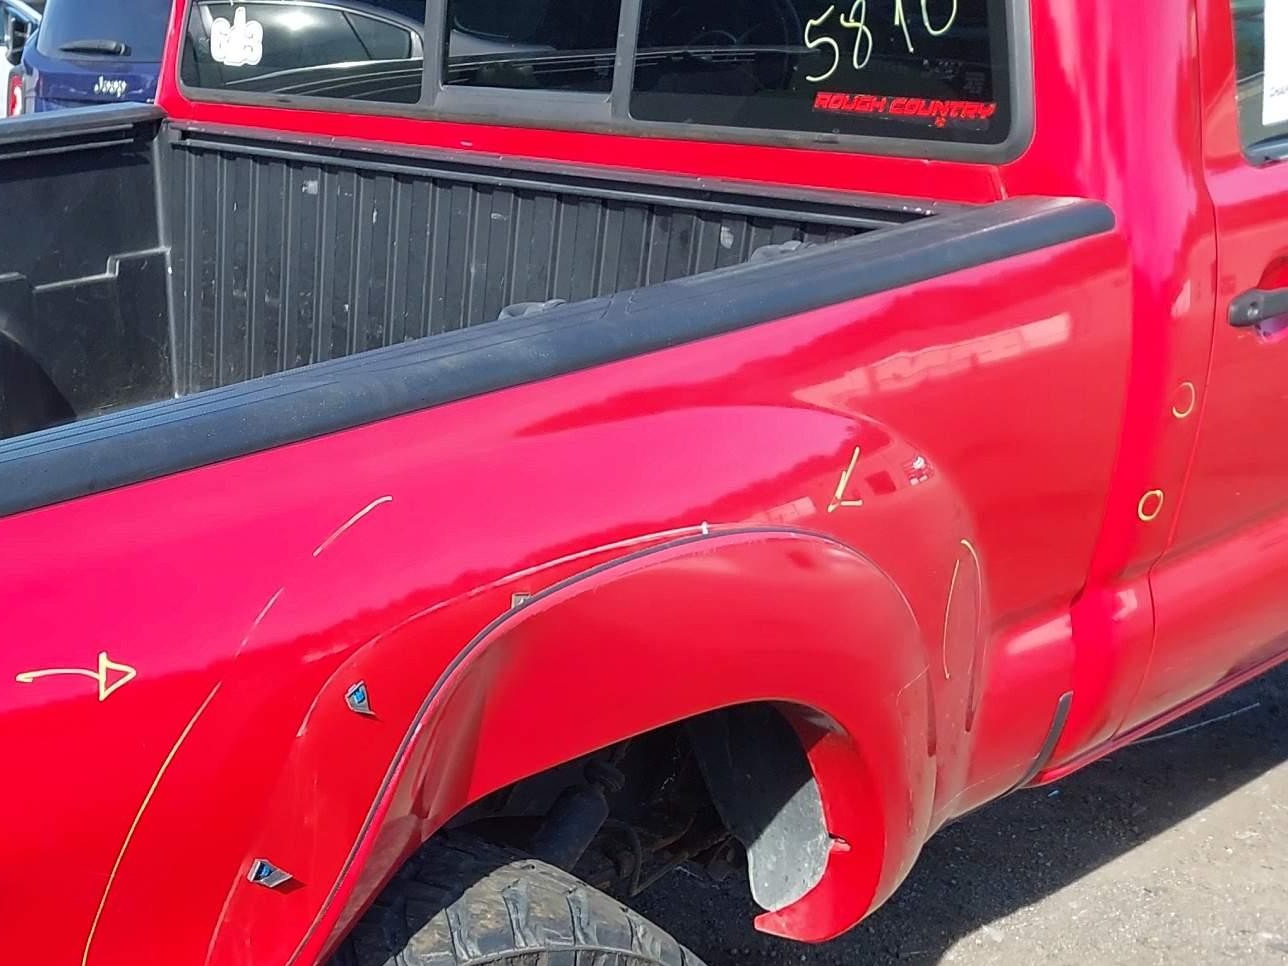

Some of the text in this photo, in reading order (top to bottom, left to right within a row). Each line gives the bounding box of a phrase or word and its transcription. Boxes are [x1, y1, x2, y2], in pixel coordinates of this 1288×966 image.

[93, 75, 128, 98] Jeep
[814, 91, 998, 119] ROUGH COUNTRY
